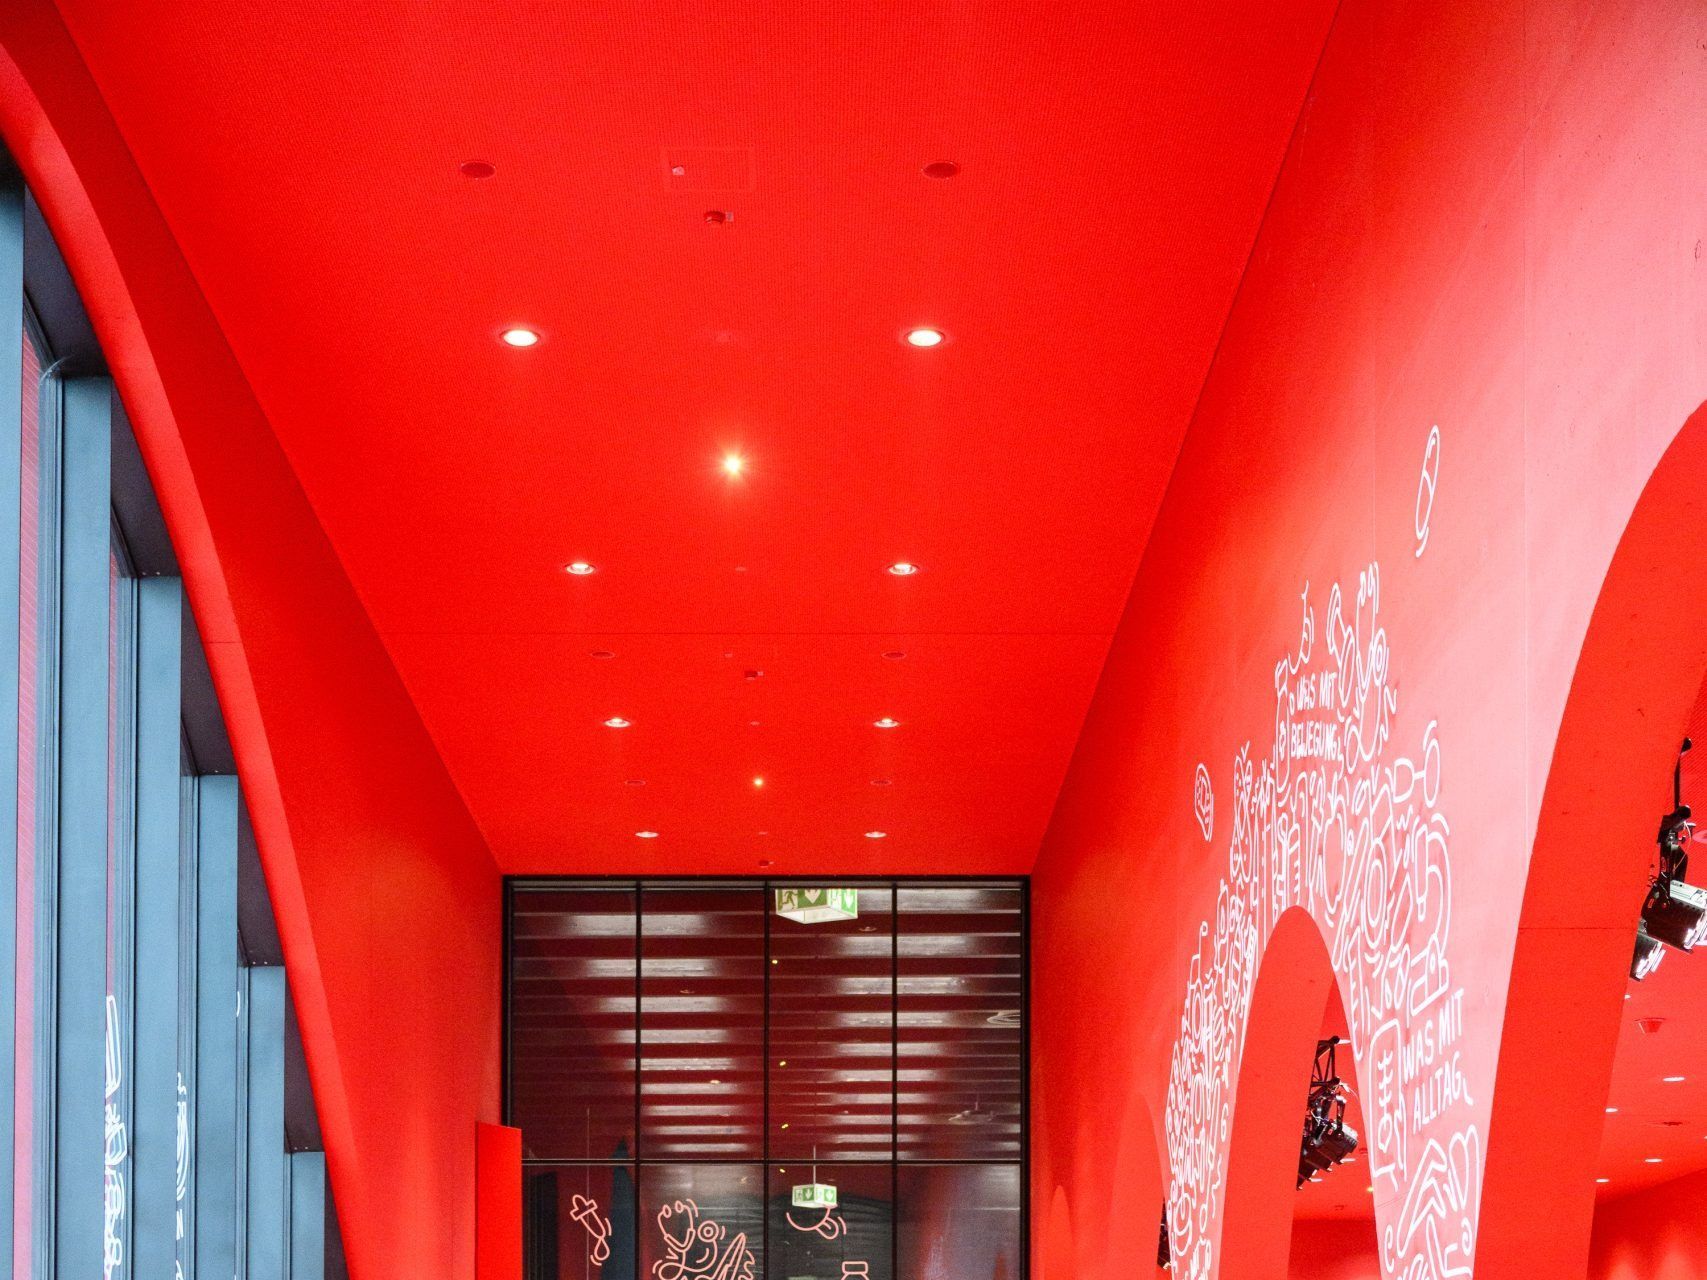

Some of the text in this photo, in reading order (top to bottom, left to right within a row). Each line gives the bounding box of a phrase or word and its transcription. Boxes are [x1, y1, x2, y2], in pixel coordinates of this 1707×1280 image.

[1297, 670, 1337, 710] WAS MIT
[1403, 988, 1464, 1084] WAS MIT
[1413, 1051, 1461, 1135] ALLTAG
